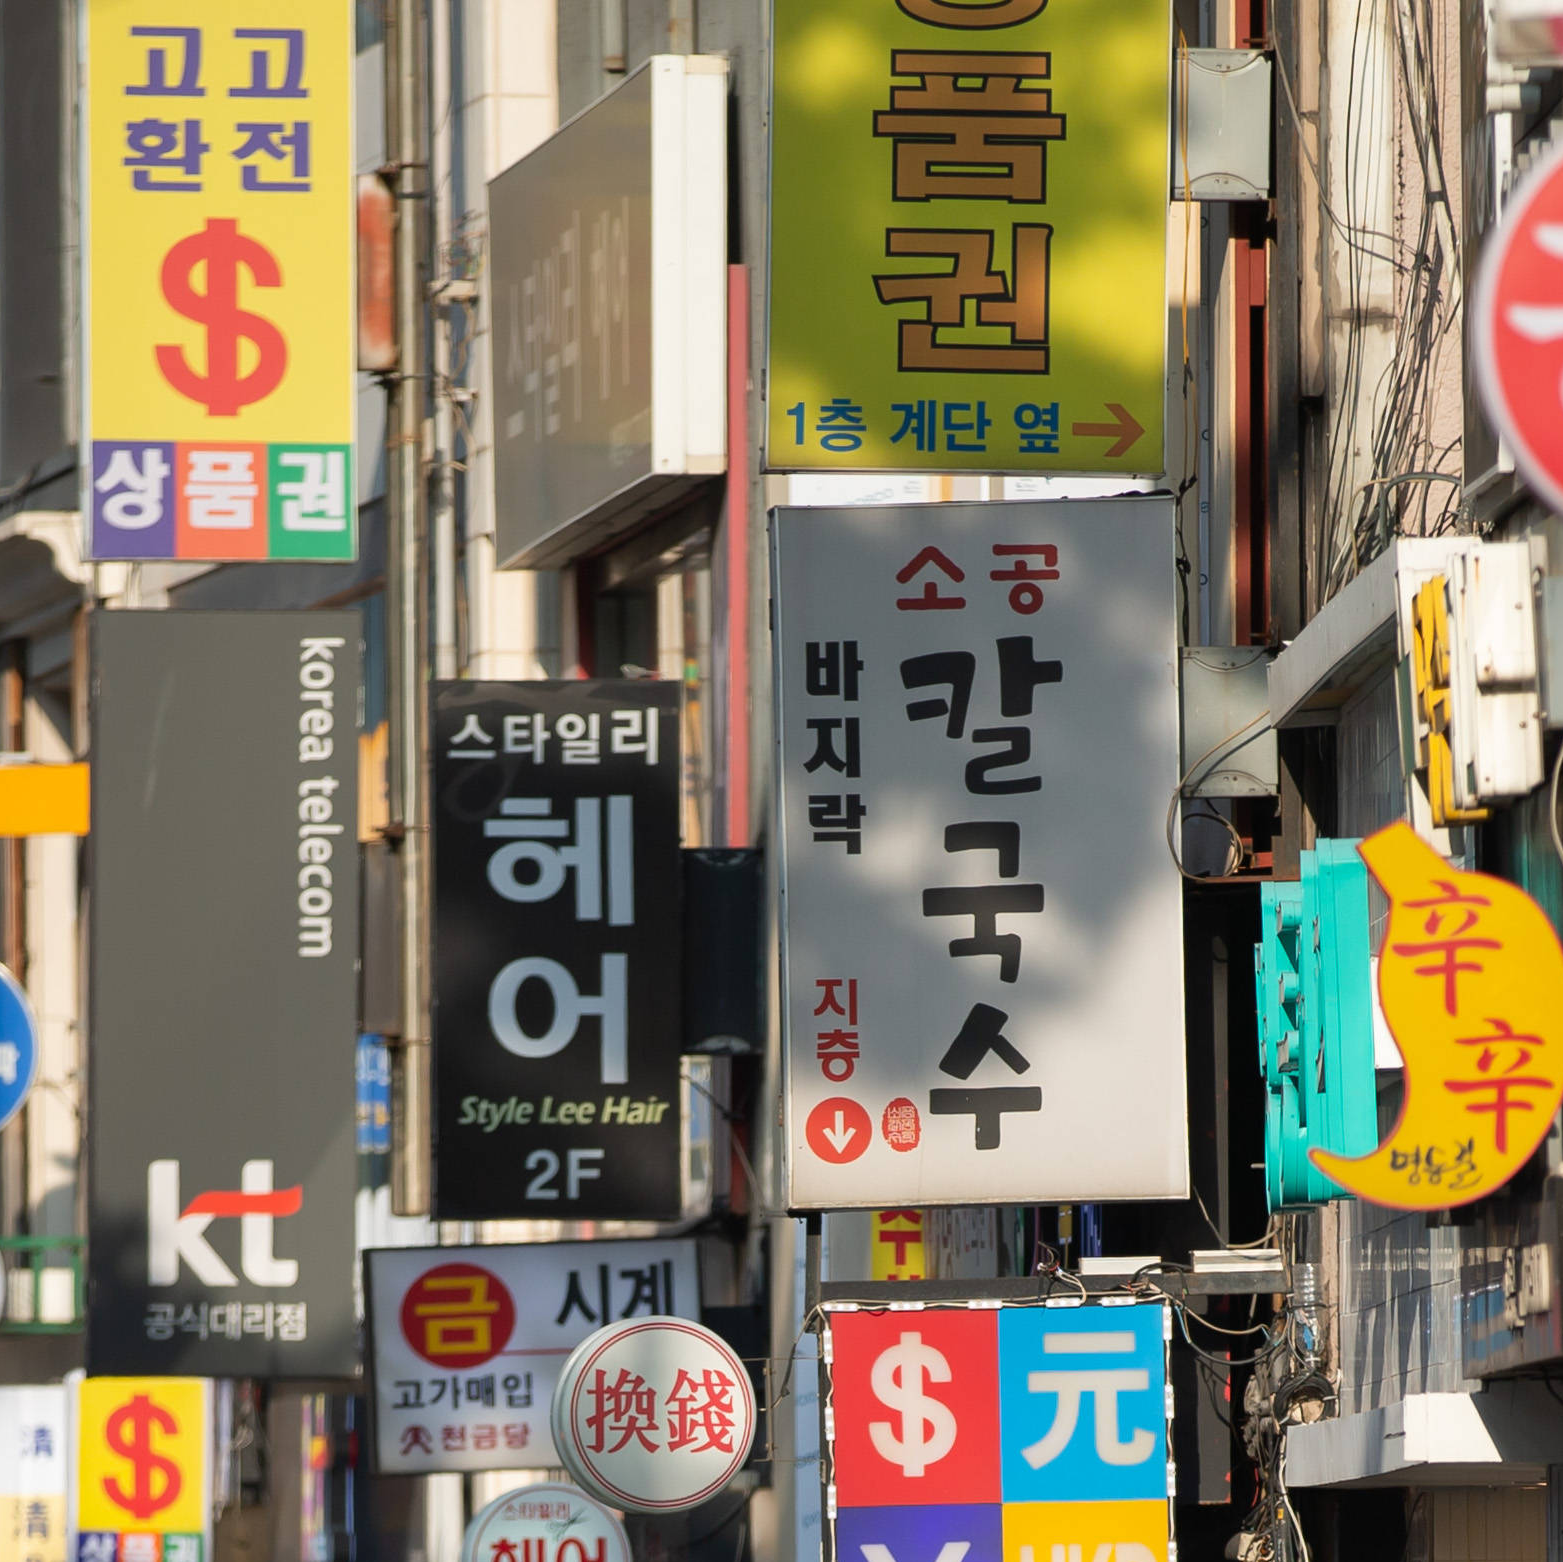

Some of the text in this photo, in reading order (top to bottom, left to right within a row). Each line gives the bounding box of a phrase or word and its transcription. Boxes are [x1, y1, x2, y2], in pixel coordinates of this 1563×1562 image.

[124, 26, 308, 98] 고고
[124, 118, 312, 193] 환전
[872, 0, 1068, 376] 품권
[154, 217, 288, 417] $
[786, 398, 1061, 455] 1층 계단 옆
[95, 448, 346, 533] 상품권
[896, 543, 1060, 616] 소공
[448, 708, 658, 764] 스타일리
[803, 639, 866, 855] 바지락
[298, 636, 345, 958] korea telecom
[899, 635, 1063, 1150] 칼국수
[483, 795, 634, 1084] 헤어
[813, 978, 861, 1082] 지층
[459, 1096, 669, 1134] Style Lee Hair
[524, 1149, 604, 1199] 2F
[147, 1159, 303, 1287] kt
[145, 1302, 307, 1342] 공식대리점
[415, 1260, 676, 1355] 금 시계
[391, 1373, 534, 1410] 고가매입
[586, 1368, 736, 1455] 換錢
[868, 1330, 1157, 1477] $ 元
[103, 1394, 182, 1521] $
[441, 1422, 531, 1451] 천금당
